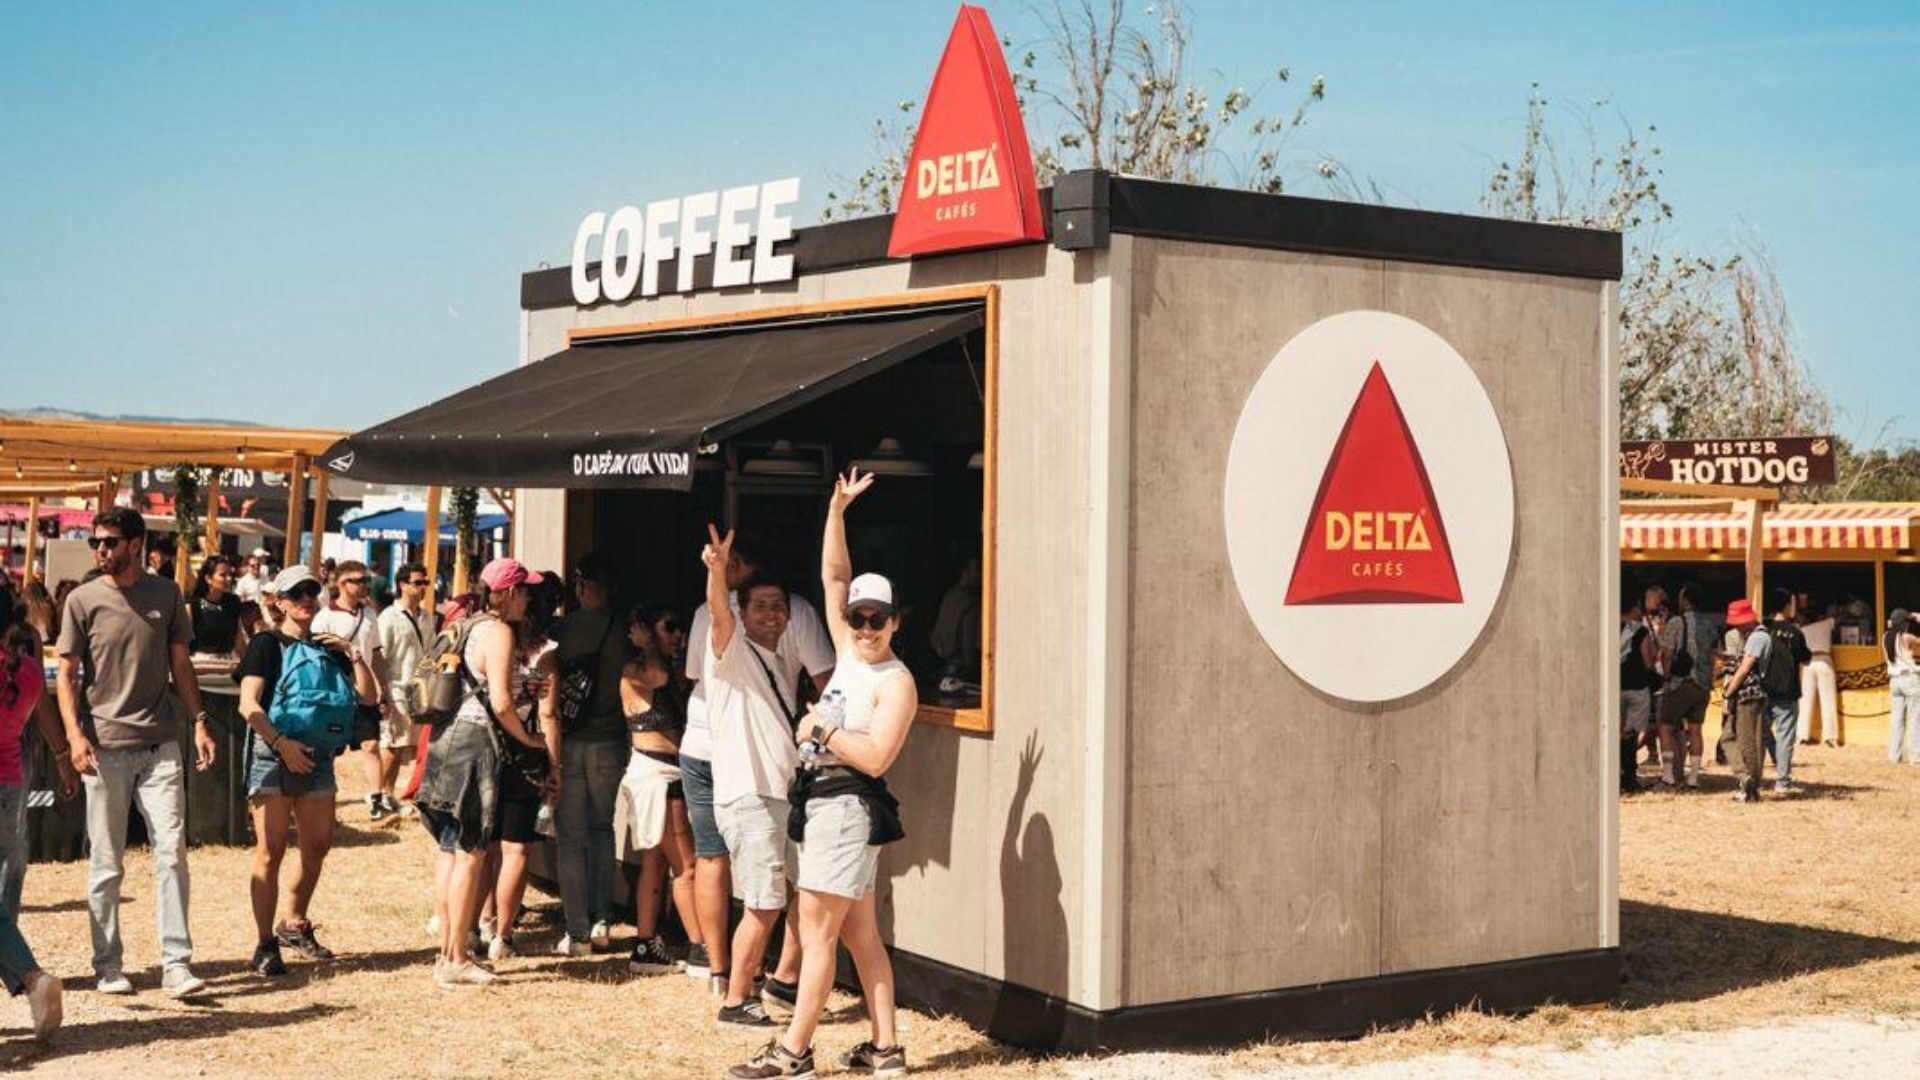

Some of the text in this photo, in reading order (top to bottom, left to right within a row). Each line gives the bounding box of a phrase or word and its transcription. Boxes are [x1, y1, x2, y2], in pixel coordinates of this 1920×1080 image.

[918, 148, 1000, 199] DELTA
[936, 201, 976, 221] CAFÉS
[571, 177, 799, 305] COFFEE
[1694, 441, 1777, 455] MISTER
[653, 452, 689, 476] VIDA
[1670, 456, 1809, 484] HOTDOG
[1326, 511, 1432, 551] DELTA
[1352, 560, 1403, 577] CAFÉS
